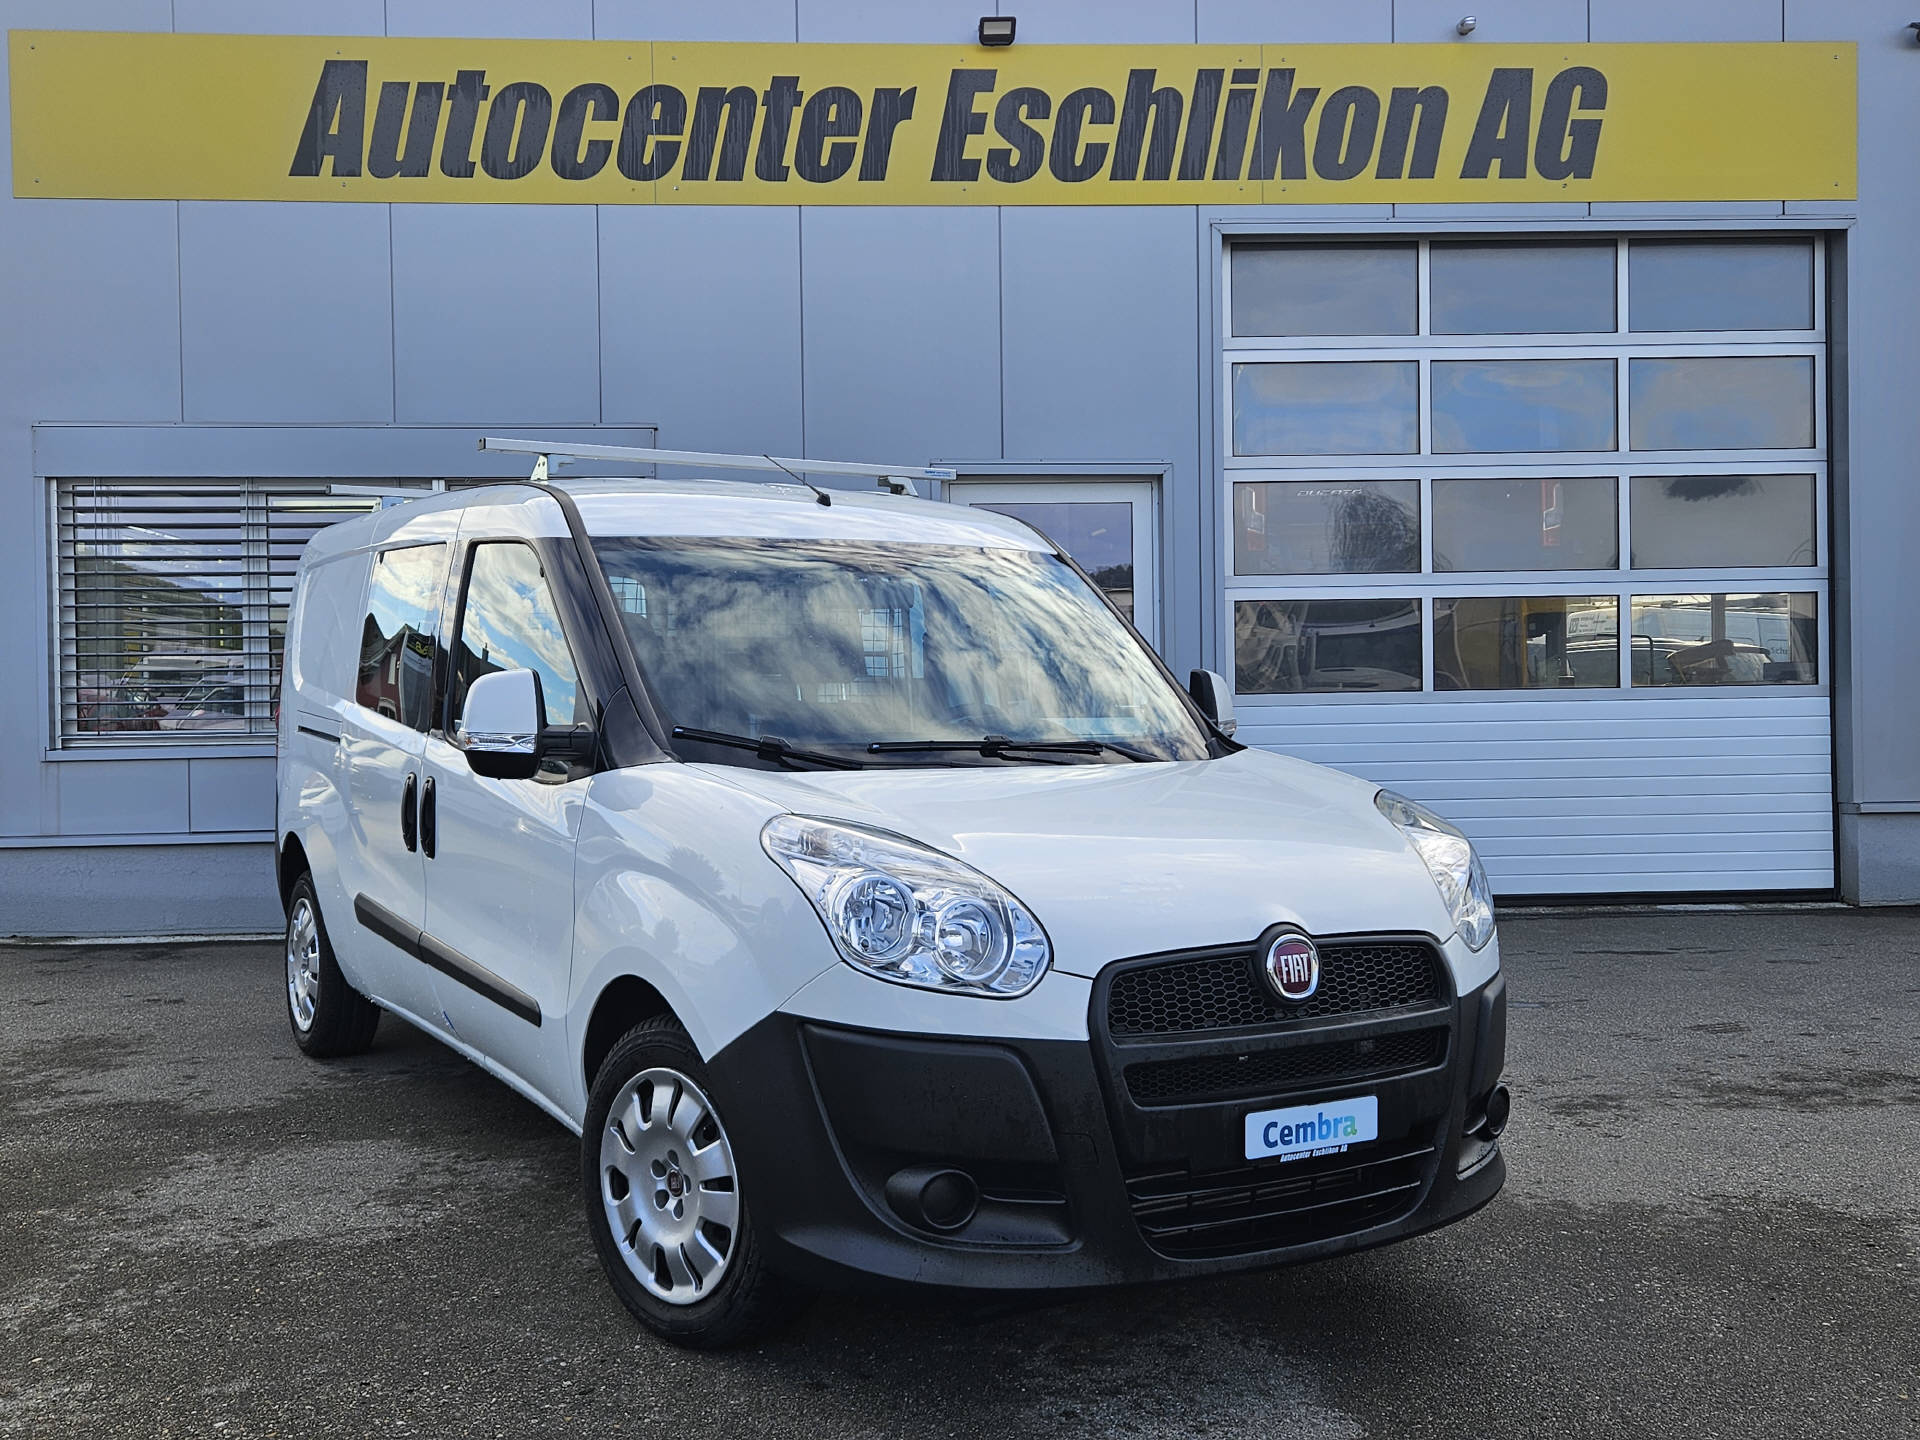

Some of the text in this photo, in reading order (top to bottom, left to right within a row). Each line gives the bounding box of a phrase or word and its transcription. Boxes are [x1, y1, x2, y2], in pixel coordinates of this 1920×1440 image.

[288, 60, 1608, 183] Autocenter Eschlikon AG
[1280, 953, 1309, 984] FIAT
[1263, 1112, 1358, 1148] Cembra
[1280, 1151, 1311, 1162] Autocenter
